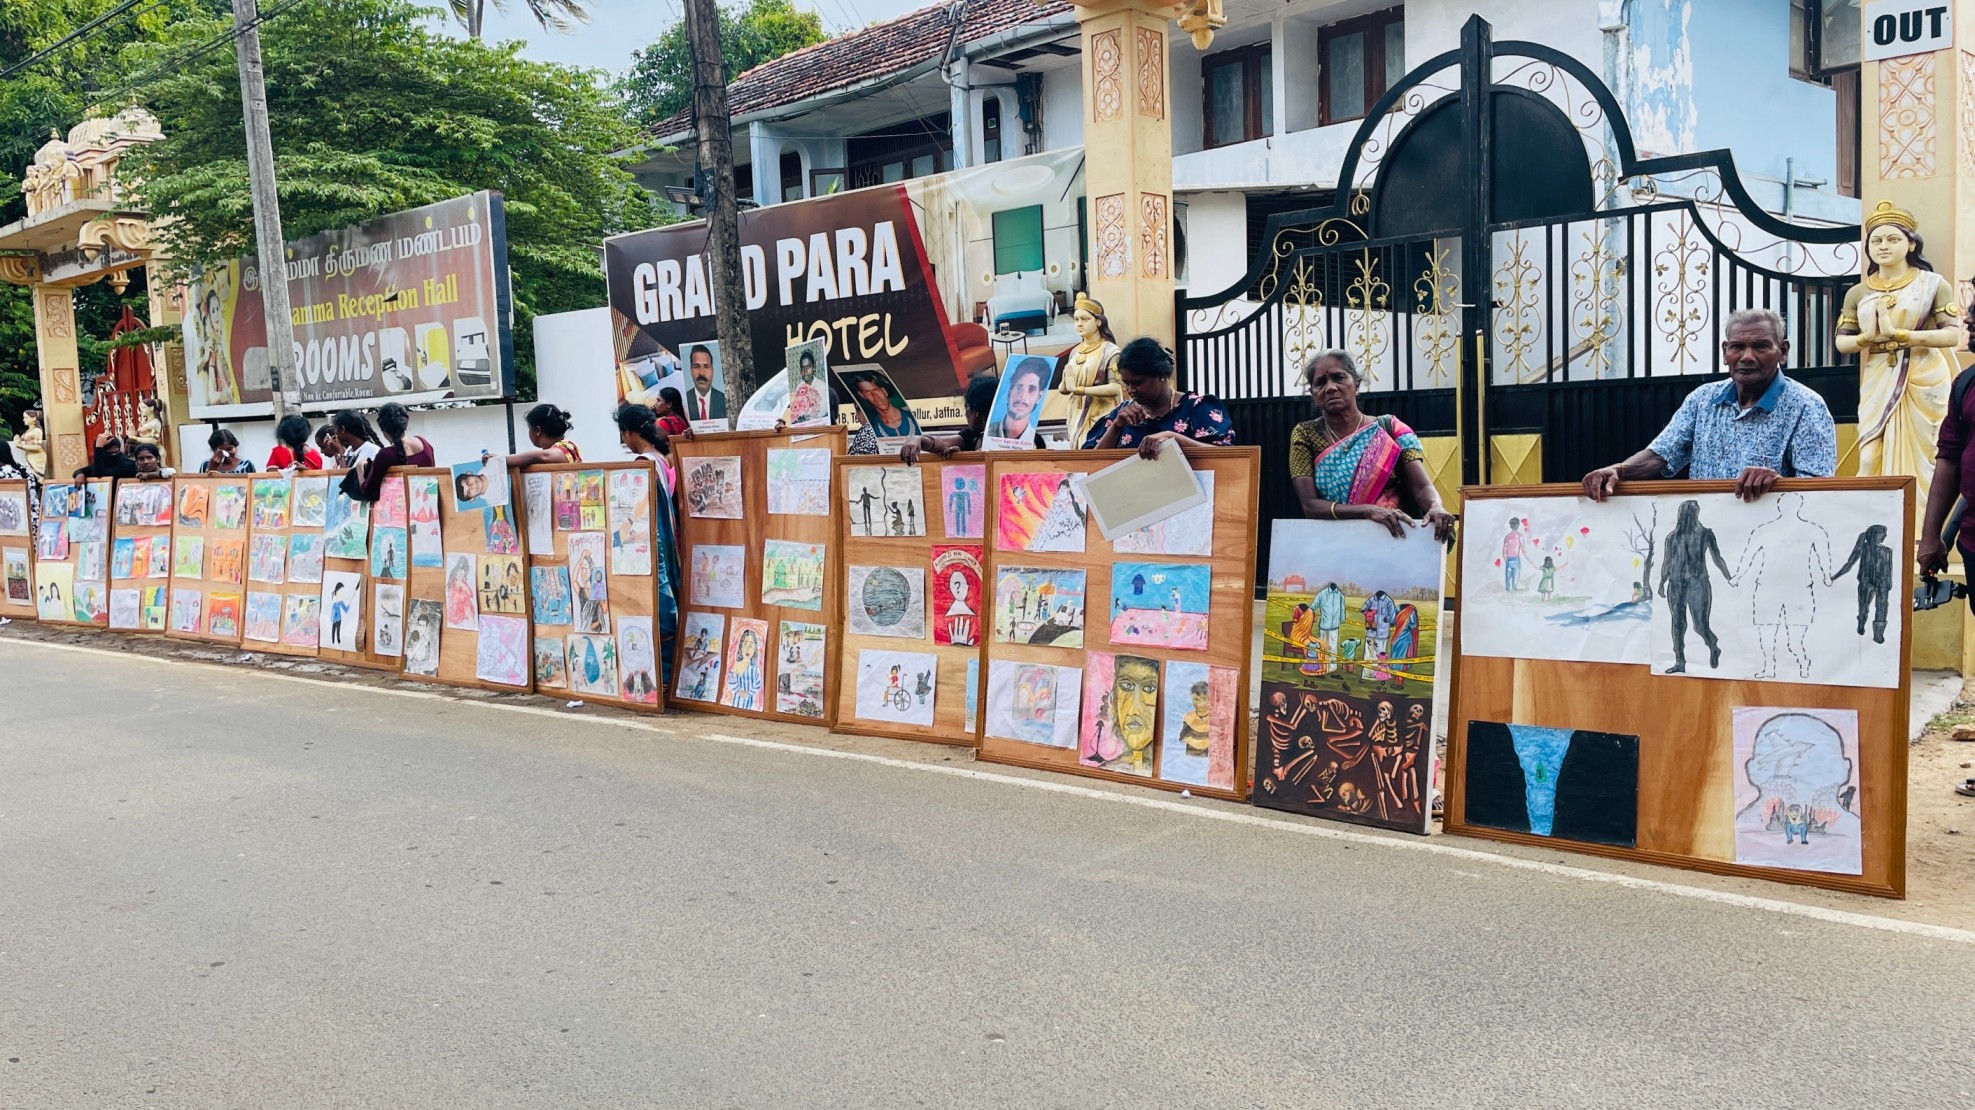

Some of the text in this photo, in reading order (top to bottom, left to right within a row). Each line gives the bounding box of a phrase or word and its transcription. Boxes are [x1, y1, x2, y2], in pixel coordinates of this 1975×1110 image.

[1873, 6, 1948, 46] OUT
[325, 238, 393, 283] திருமண
[397, 206, 482, 260] மண்டபம்
[291, 272, 459, 326] amma Reception Hall
[633, 220, 906, 326] GRAD PARA
[293, 331, 376, 389] ROOMS
[354, 388, 374, 398] Rooms
[912, 408, 932, 421] allur,
[934, 406, 963, 419] Jaffna.
